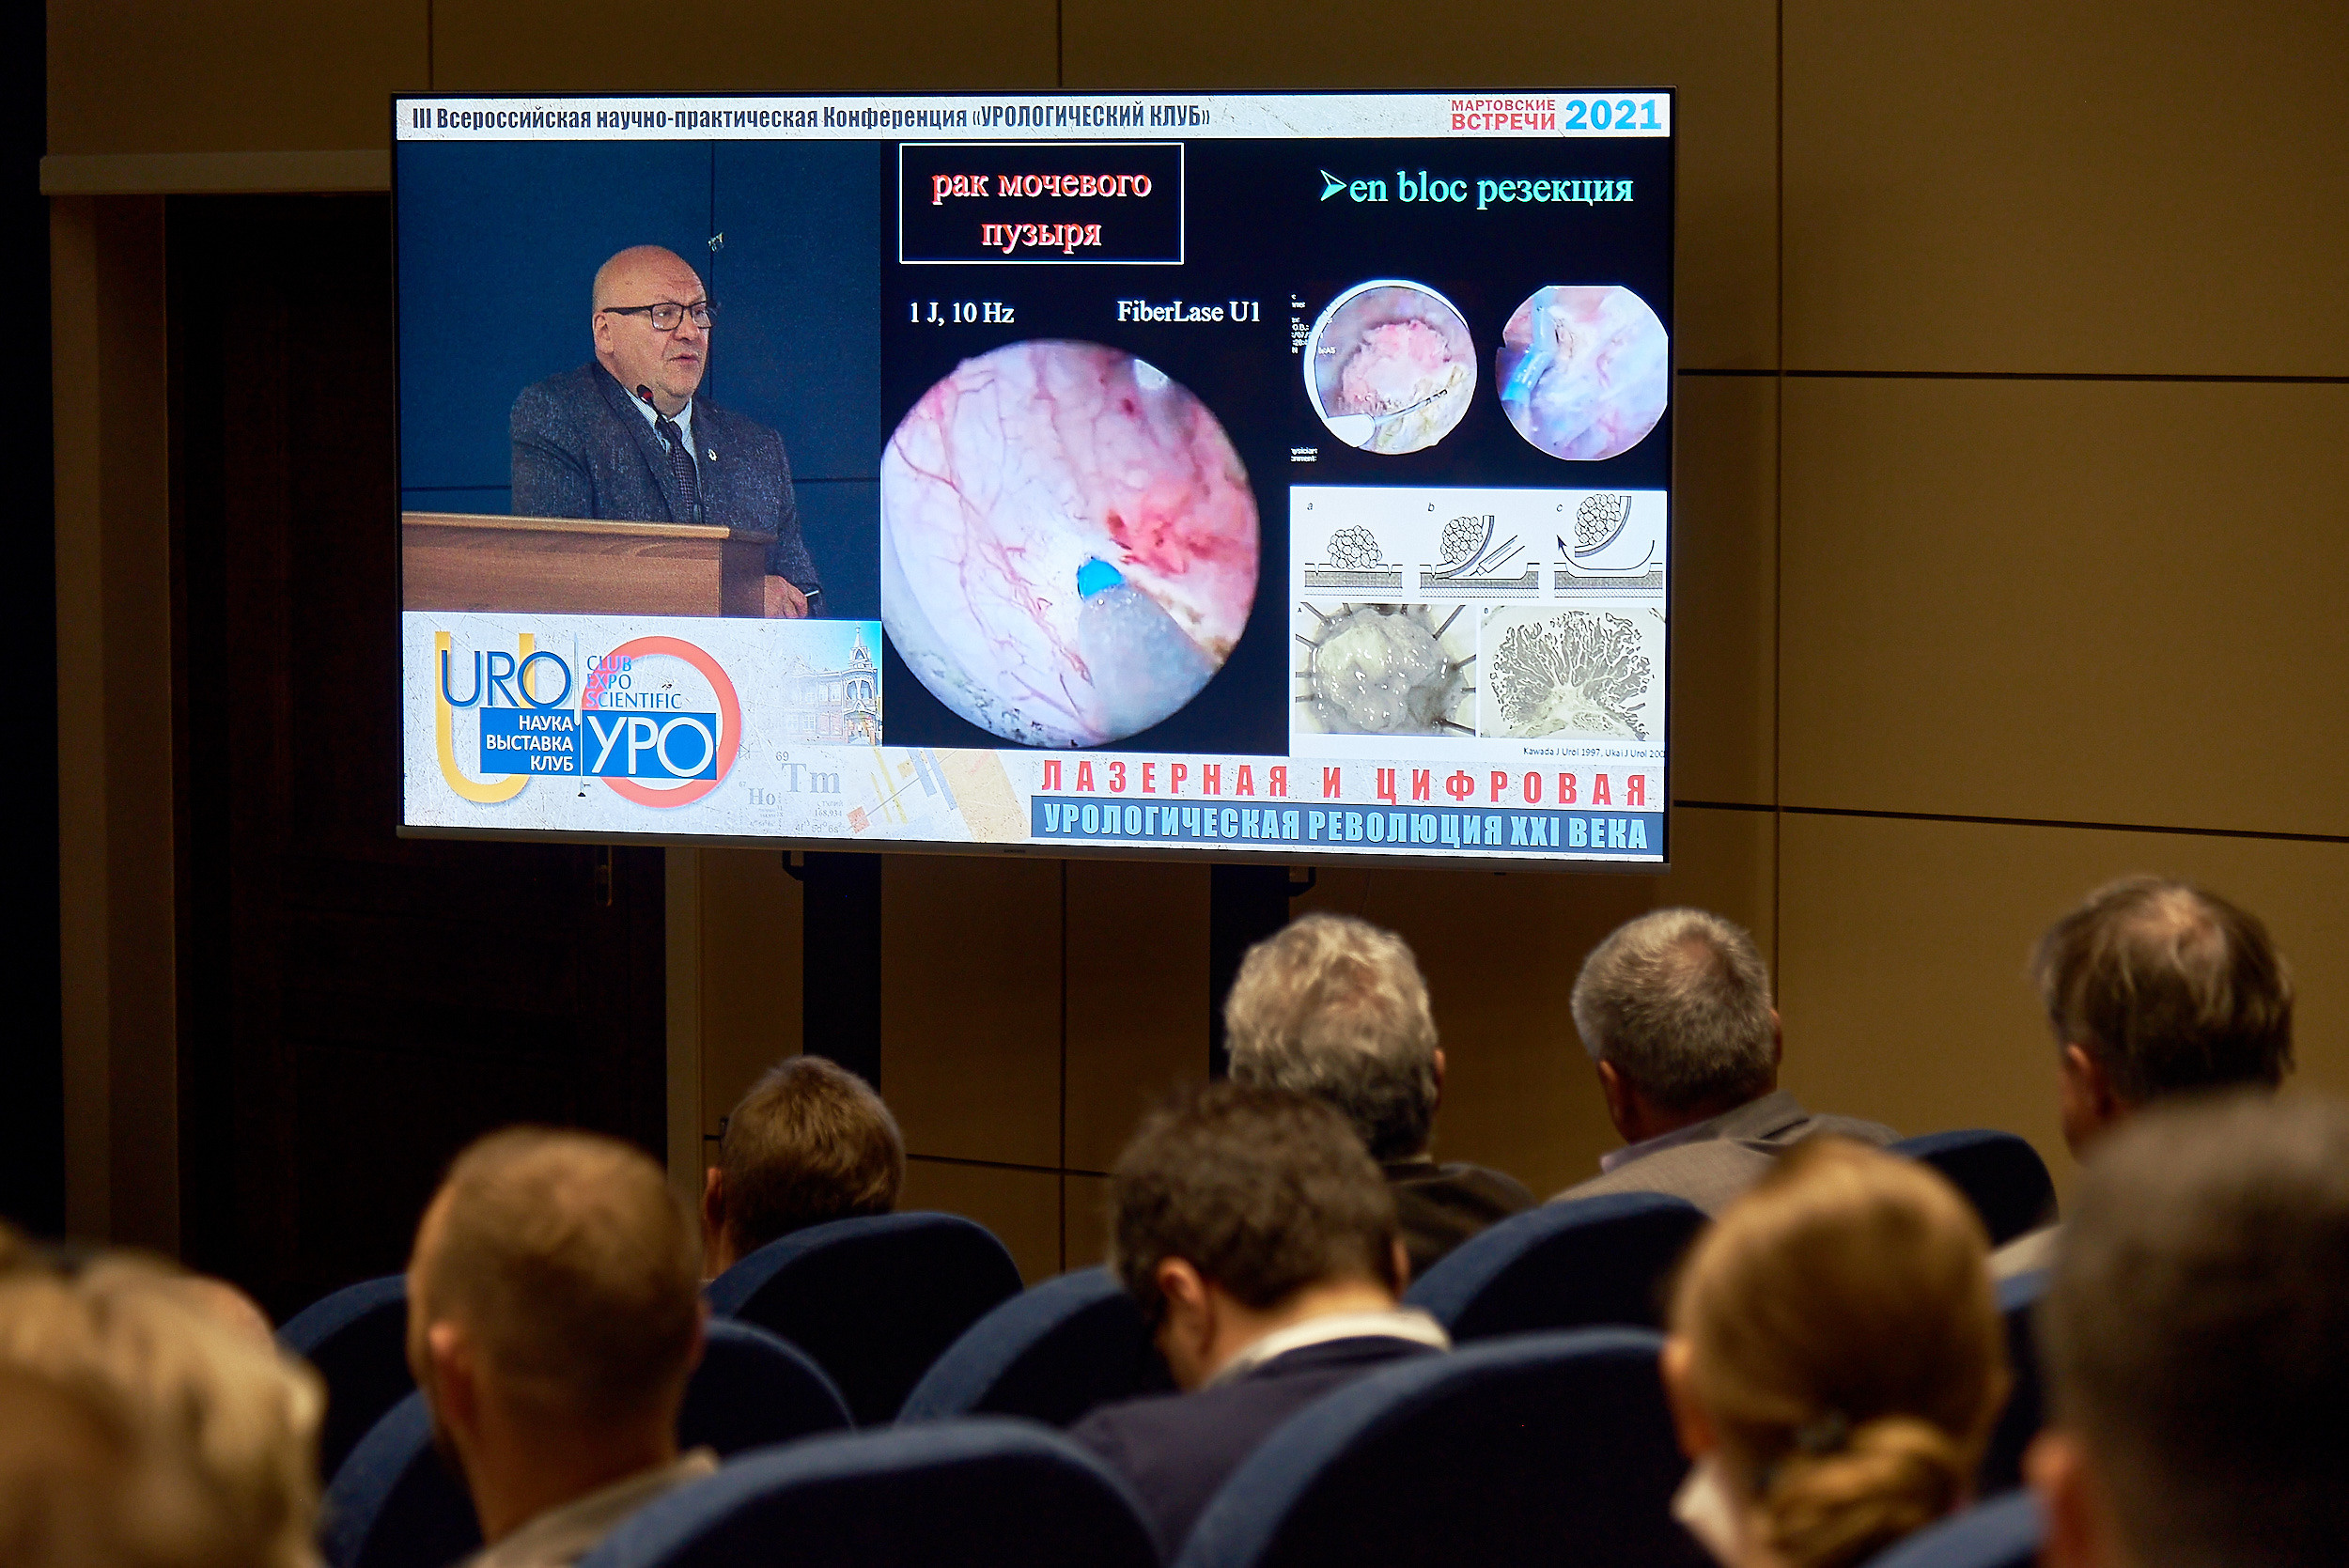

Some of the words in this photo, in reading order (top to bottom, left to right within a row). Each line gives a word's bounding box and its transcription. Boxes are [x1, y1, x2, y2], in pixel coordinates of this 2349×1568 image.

[1452, 100, 1556, 112] МАРТОВСКИЕ
[1565, 99, 1662, 130] 2021
[437, 106, 591, 131] Всероссийская
[597, 110, 817, 130] научно-практическая
[823, 106, 967, 130] Конференция
[972, 101, 1144, 127] «УРОЛОГИЧЕСКИЙ
[1150, 104, 1210, 127] КЛУБ»
[1452, 114, 1556, 131] ВСТРЕЧИ
[931, 174, 989, 205] рак
[998, 174, 1152, 197] мочевого
[1349, 179, 1389, 202] en
[1396, 170, 1468, 202] bloc
[1476, 179, 1634, 210] резекция
[981, 223, 1102, 255] пузыря
[910, 303, 919, 323] 1
[926, 303, 945, 326] J,
[953, 303, 978, 323] 10
[983, 303, 1015, 323] Hz
[1117, 300, 1224, 322] FiberLase
[1230, 302, 1261, 322] U1
[1306, 501, 1314, 511] a
[1427, 502, 1436, 513] b
[1556, 503, 1563, 513] c
[586, 655, 632, 672] CLUB
[441, 649, 571, 707] URO
[586, 673, 632, 690] EXPO
[586, 691, 682, 709] SCIENTIFIC
[519, 714, 574, 732] НАУКА
[486, 734, 574, 752] ВЫСТАВКА
[586, 715, 714, 778] УРО
[775, 751, 789, 762] 69
[1523, 747, 1554, 755] Kawada
[1562, 748, 1579, 756] Urol
[1630, 749, 1647, 758] Urol
[530, 754, 574, 772] КЛУБ
[781, 763, 841, 794] Tm
[1041, 759, 1287, 797] ЛАЗЕРНАЯ
[1323, 766, 1341, 798] И
[1377, 768, 1645, 806] ЦИФРОВАЯ
[748, 787, 776, 806] Ho
[1044, 803, 1299, 840] УРОЛОГИЧЕСКАЯ
[1309, 810, 1502, 848] РЕВОЛЮЦИЯ
[1510, 815, 1560, 846] XXI
[1568, 816, 1648, 849] ВЕКА
